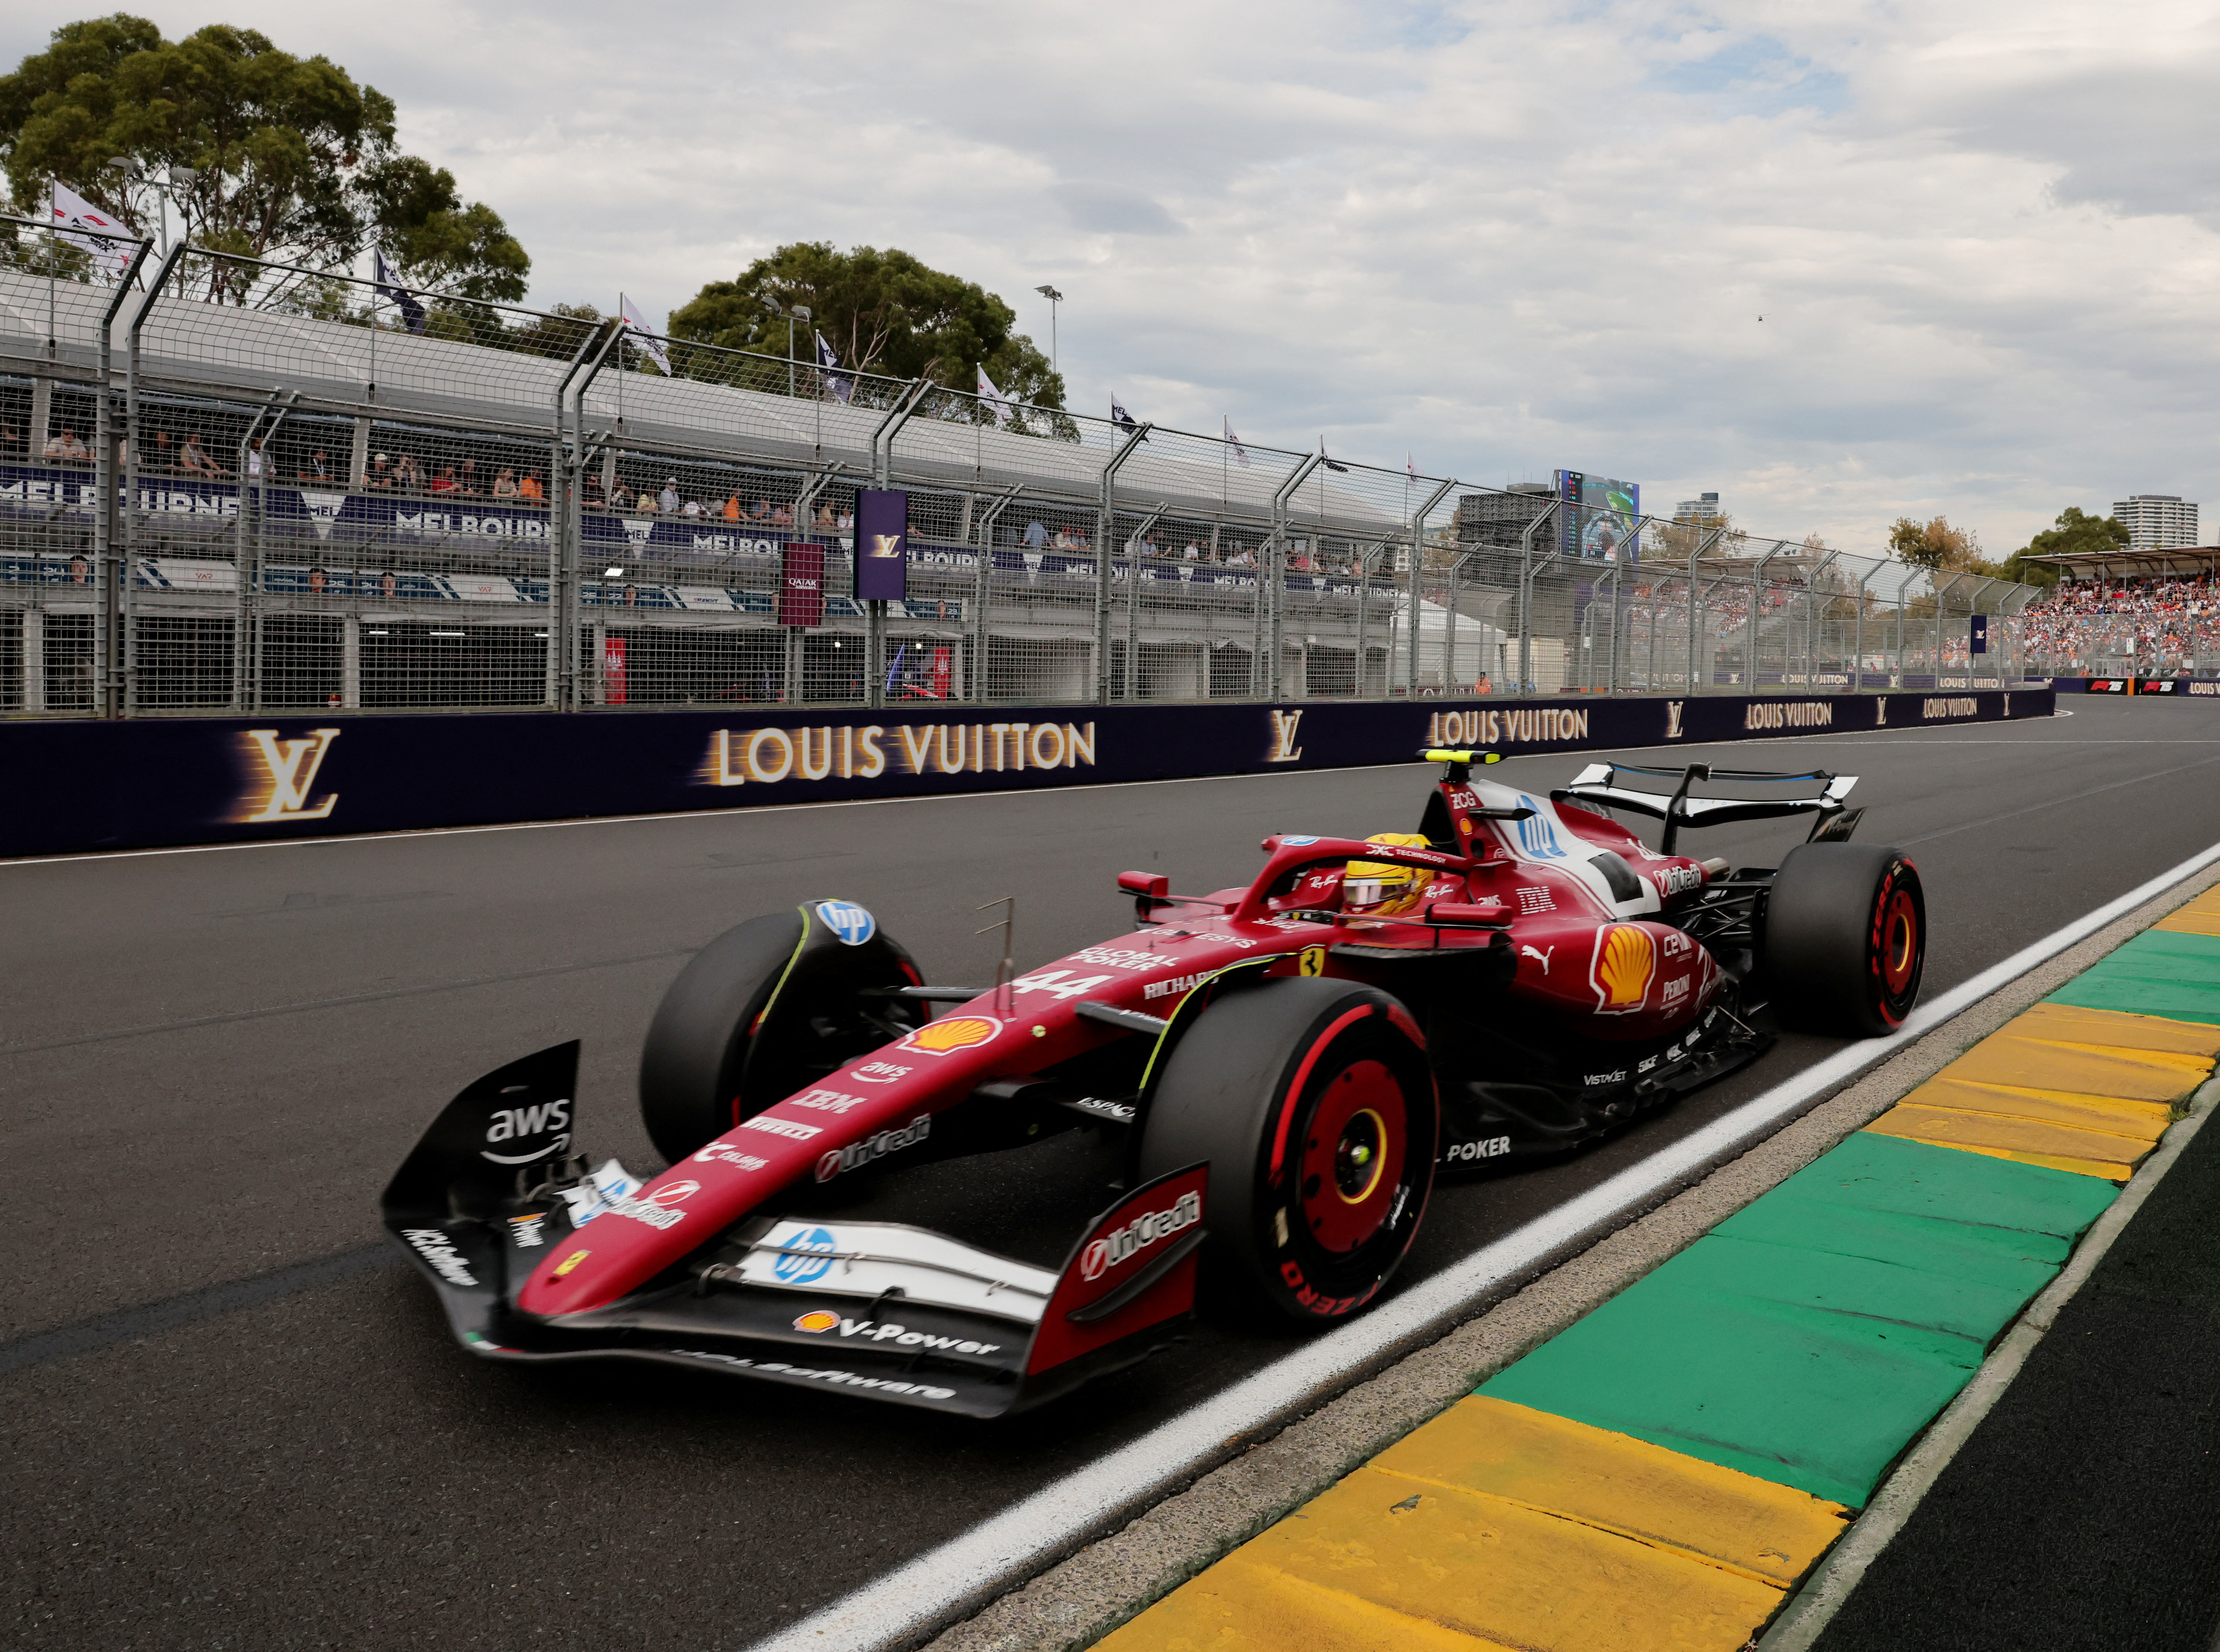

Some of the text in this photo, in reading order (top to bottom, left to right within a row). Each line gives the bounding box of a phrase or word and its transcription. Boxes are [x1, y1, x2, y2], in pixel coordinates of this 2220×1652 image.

[789, 577, 817, 586] QATAR
[2108, 681, 2124, 692] 75
[1747, 702, 1832, 730] LOUIS VUITTON
[1923, 697, 1978, 719] LOUIS VUITTON
[1433, 708, 1588, 748] LOUIS VUITTON
[720, 721, 1098, 786] LOUIS VUITTON
[1450, 791, 1477, 810] ZCG
[1395, 849, 1447, 864] TECHNOLOGY
[1066, 954, 1159, 971] POKER
[1079, 947, 1181, 966] GLOBAL
[1011, 969, 1115, 999] 44
[859, 1062, 914, 1078] aws
[789, 1089, 868, 1114] IBM
[486, 1099, 570, 1143] aws
[1447, 1135, 1511, 1162] POKER
[775, 1227, 834, 1283] hp
[839, 1318, 1001, 1356] V-Power
